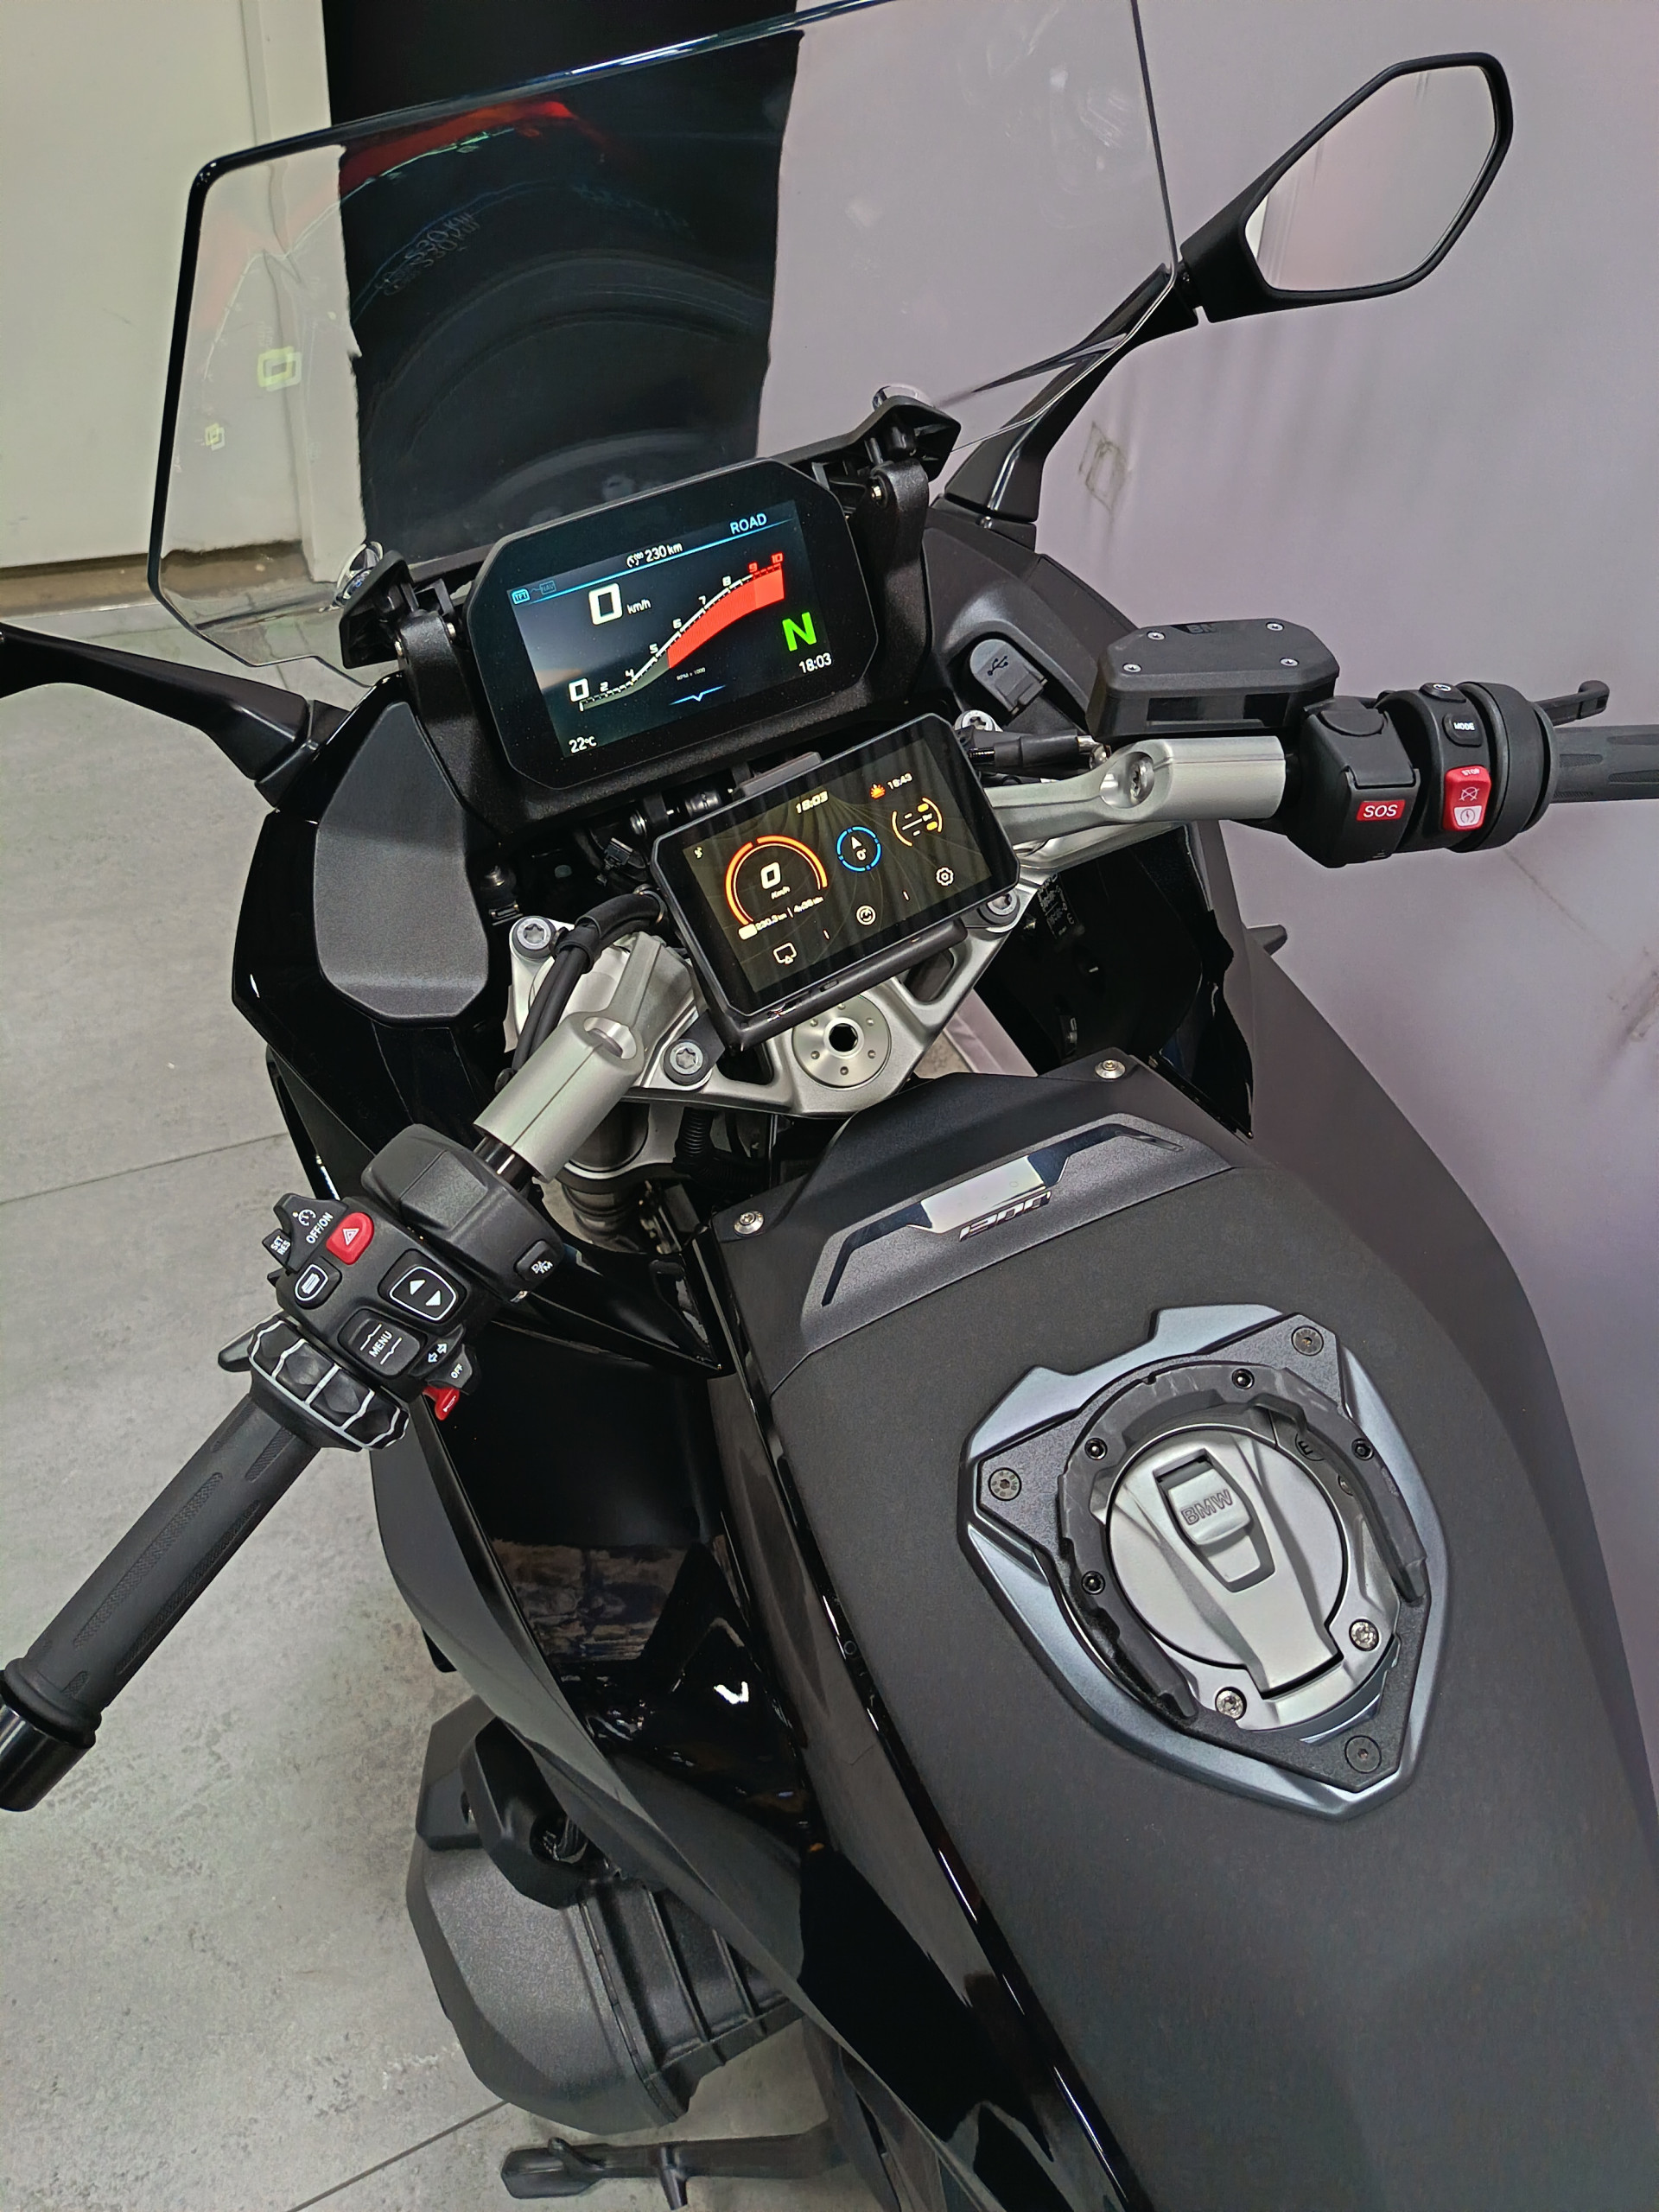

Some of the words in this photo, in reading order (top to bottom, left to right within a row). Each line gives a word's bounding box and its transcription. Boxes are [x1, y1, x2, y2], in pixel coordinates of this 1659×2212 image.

[730, 513, 767, 535] ROAD
[645, 545, 667, 563] 230
[667, 543, 683, 556] km
[772, 552, 784, 564] 10
[748, 563, 758, 573] 9
[722, 575, 732, 587] 8
[588, 582, 623, 626] 0
[626, 598, 652, 614] km/h
[698, 595, 707, 605] 7
[672, 619, 682, 629] 6
[782, 611, 817, 652] N
[649, 643, 658, 654] 5
[799, 652, 832, 674] 18:03
[625, 669, 634, 679] 4
[569, 677, 590, 702] 0
[600, 681, 609, 692] 2
[1453, 721, 1476, 731] MODE
[1461, 768, 1480, 777] STOP
[796, 791, 829, 814] 18:03
[1363, 804, 1399, 819] SOS
[760, 861, 781, 890] 0
[306, 1211, 334, 1244] OFF/ON
[270, 1236, 283, 1251] SET
[276, 1240, 291, 1255] RES
[369, 1331, 393, 1357] MENU
[450, 1363, 463, 1379] OFF
[1180, 1488, 1233, 1526] BMW
